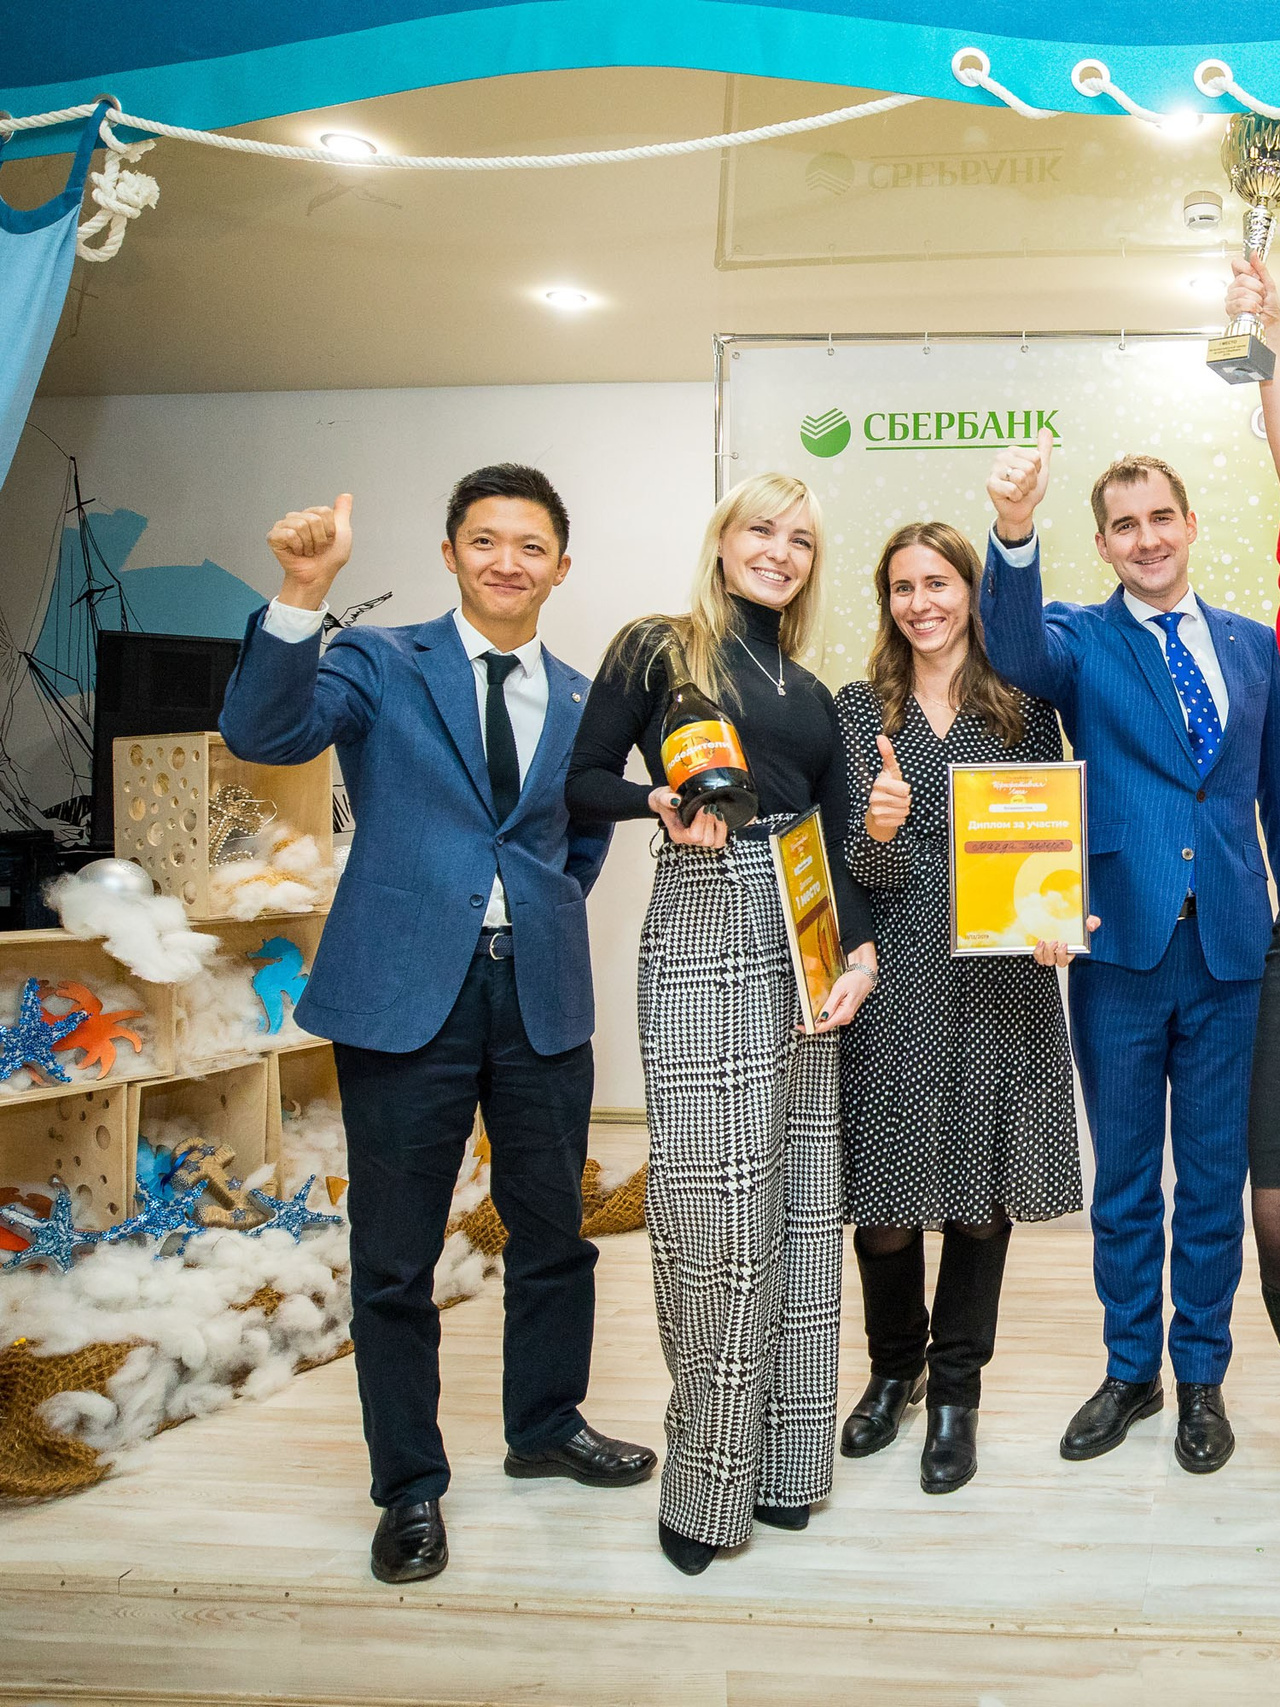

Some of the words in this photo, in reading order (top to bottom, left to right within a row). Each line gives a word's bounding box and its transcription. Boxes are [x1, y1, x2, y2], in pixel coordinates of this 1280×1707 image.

[863, 409, 1061, 442] СБЕРБАНК
[968, 820, 1011, 831] Диплом
[1013, 821, 1025, 829] за
[1027, 820, 1069, 831] участие
